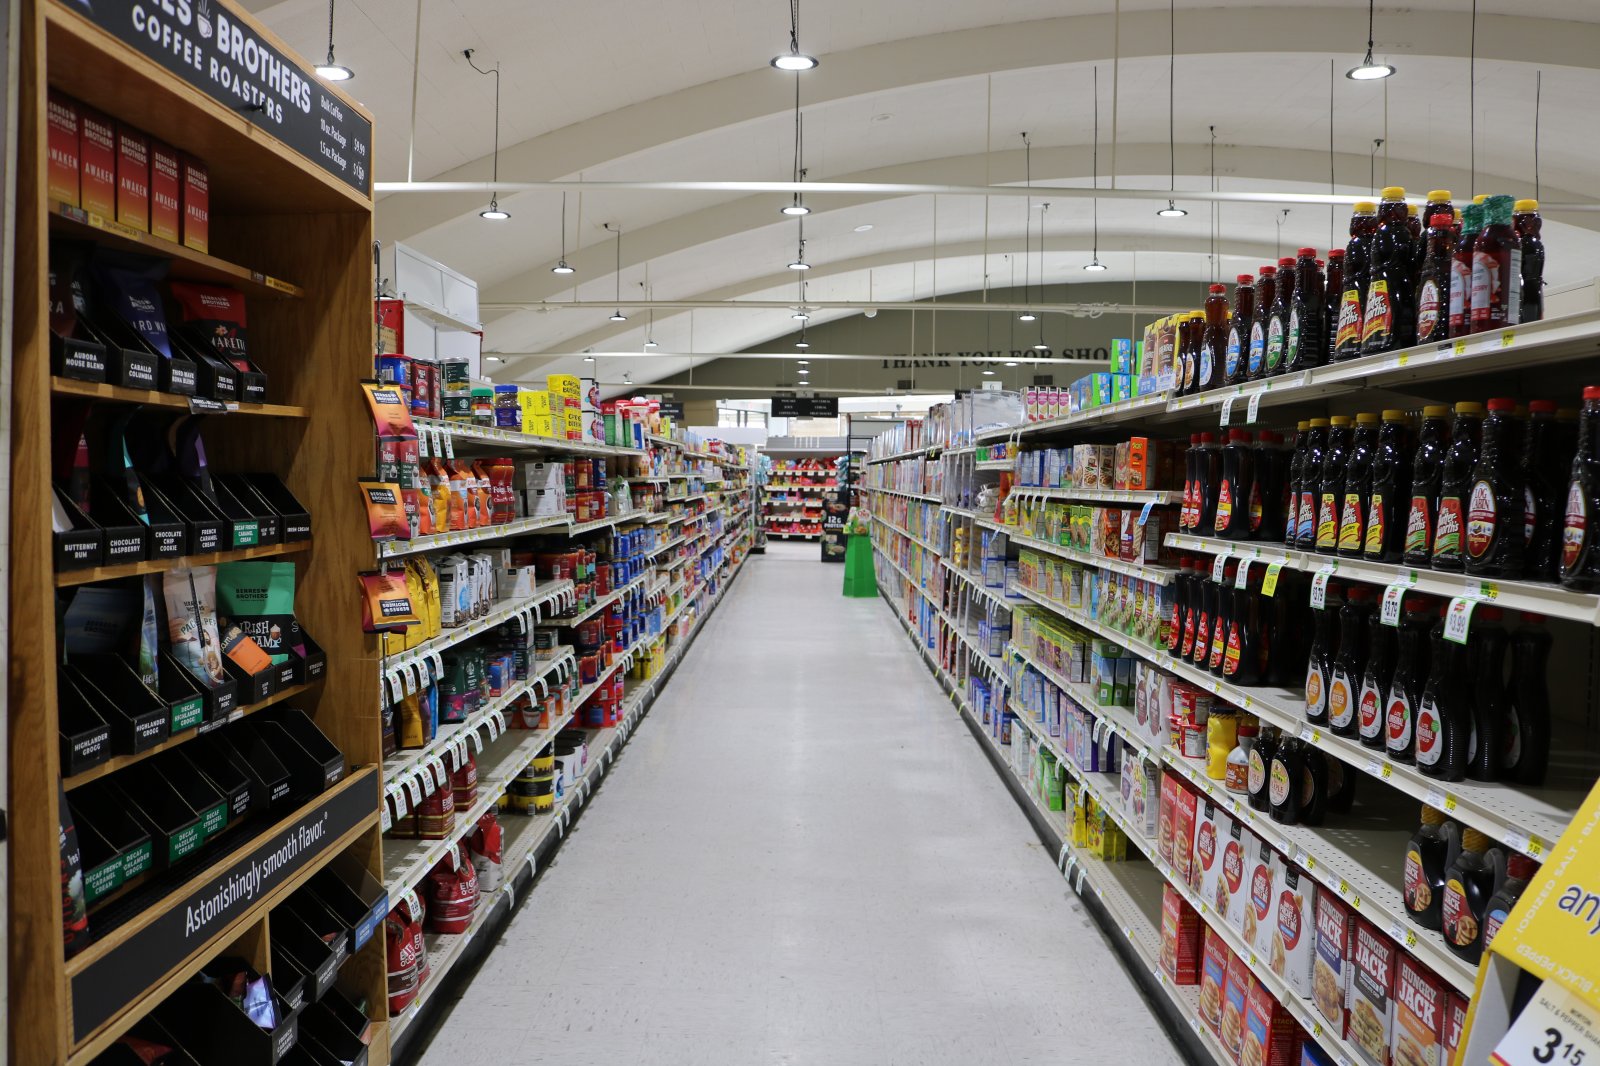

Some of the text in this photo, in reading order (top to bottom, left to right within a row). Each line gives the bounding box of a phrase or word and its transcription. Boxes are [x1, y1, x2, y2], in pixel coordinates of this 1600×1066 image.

[132, 5, 283, 124] COFFEE ROASTERS
[217, 13, 311, 114] BROTHERS
[331, 126, 347, 149] Package
[331, 148, 347, 171] Package
[85, 163, 114, 184] AWAKEN
[121, 177, 148, 198] AWAKEN
[155, 192, 179, 211] AWAKEN
[188, 204, 208, 222] AWAKEN
[66, 358, 105, 371] HOUSE BLEND
[74, 351, 97, 362] AURORA
[882, 352, 951, 369] THANK
[957, 351, 1002, 367] YOU
[1010, 349, 1053, 365] FOR
[131, 362, 152, 374] CABALLO
[64, 543, 97, 552] BUTTERNUT
[110, 537, 141, 546] CHOCOLATE
[110, 545, 140, 554] RASPBERRY
[160, 544, 177, 552] COOKIE
[74, 551, 87, 559] RUM
[174, 708, 200, 722] HIGHLANDER
[181, 704, 195, 713] DECAF
[136, 718, 166, 733] HIGHLANDER
[74, 732, 108, 752] HIGHLANDER
[206, 809, 219, 821] DECAF
[174, 833, 198, 850] HAZELNUT
[178, 828, 194, 841] DECAF
[126, 848, 143, 862] DECAF
[178, 843, 194, 855] CREAM
[85, 860, 122, 885] DECAF FRENCH
[92, 873, 116, 888] CARAMEL
[95, 881, 113, 895] CREAM
[186, 833, 298, 938] Astonishingly smooth
[1517, 845, 1580, 934] IODIZED SALT
[1320, 895, 1344, 926] HUNGRY
[1317, 912, 1342, 950] JACK
[1358, 927, 1389, 961] HUNGRY
[1355, 945, 1389, 988] JACK
[1516, 943, 1593, 994] BLACK PEPPER
[1401, 962, 1437, 1003] HUNGRY
[1398, 977, 1437, 1032] JACK
